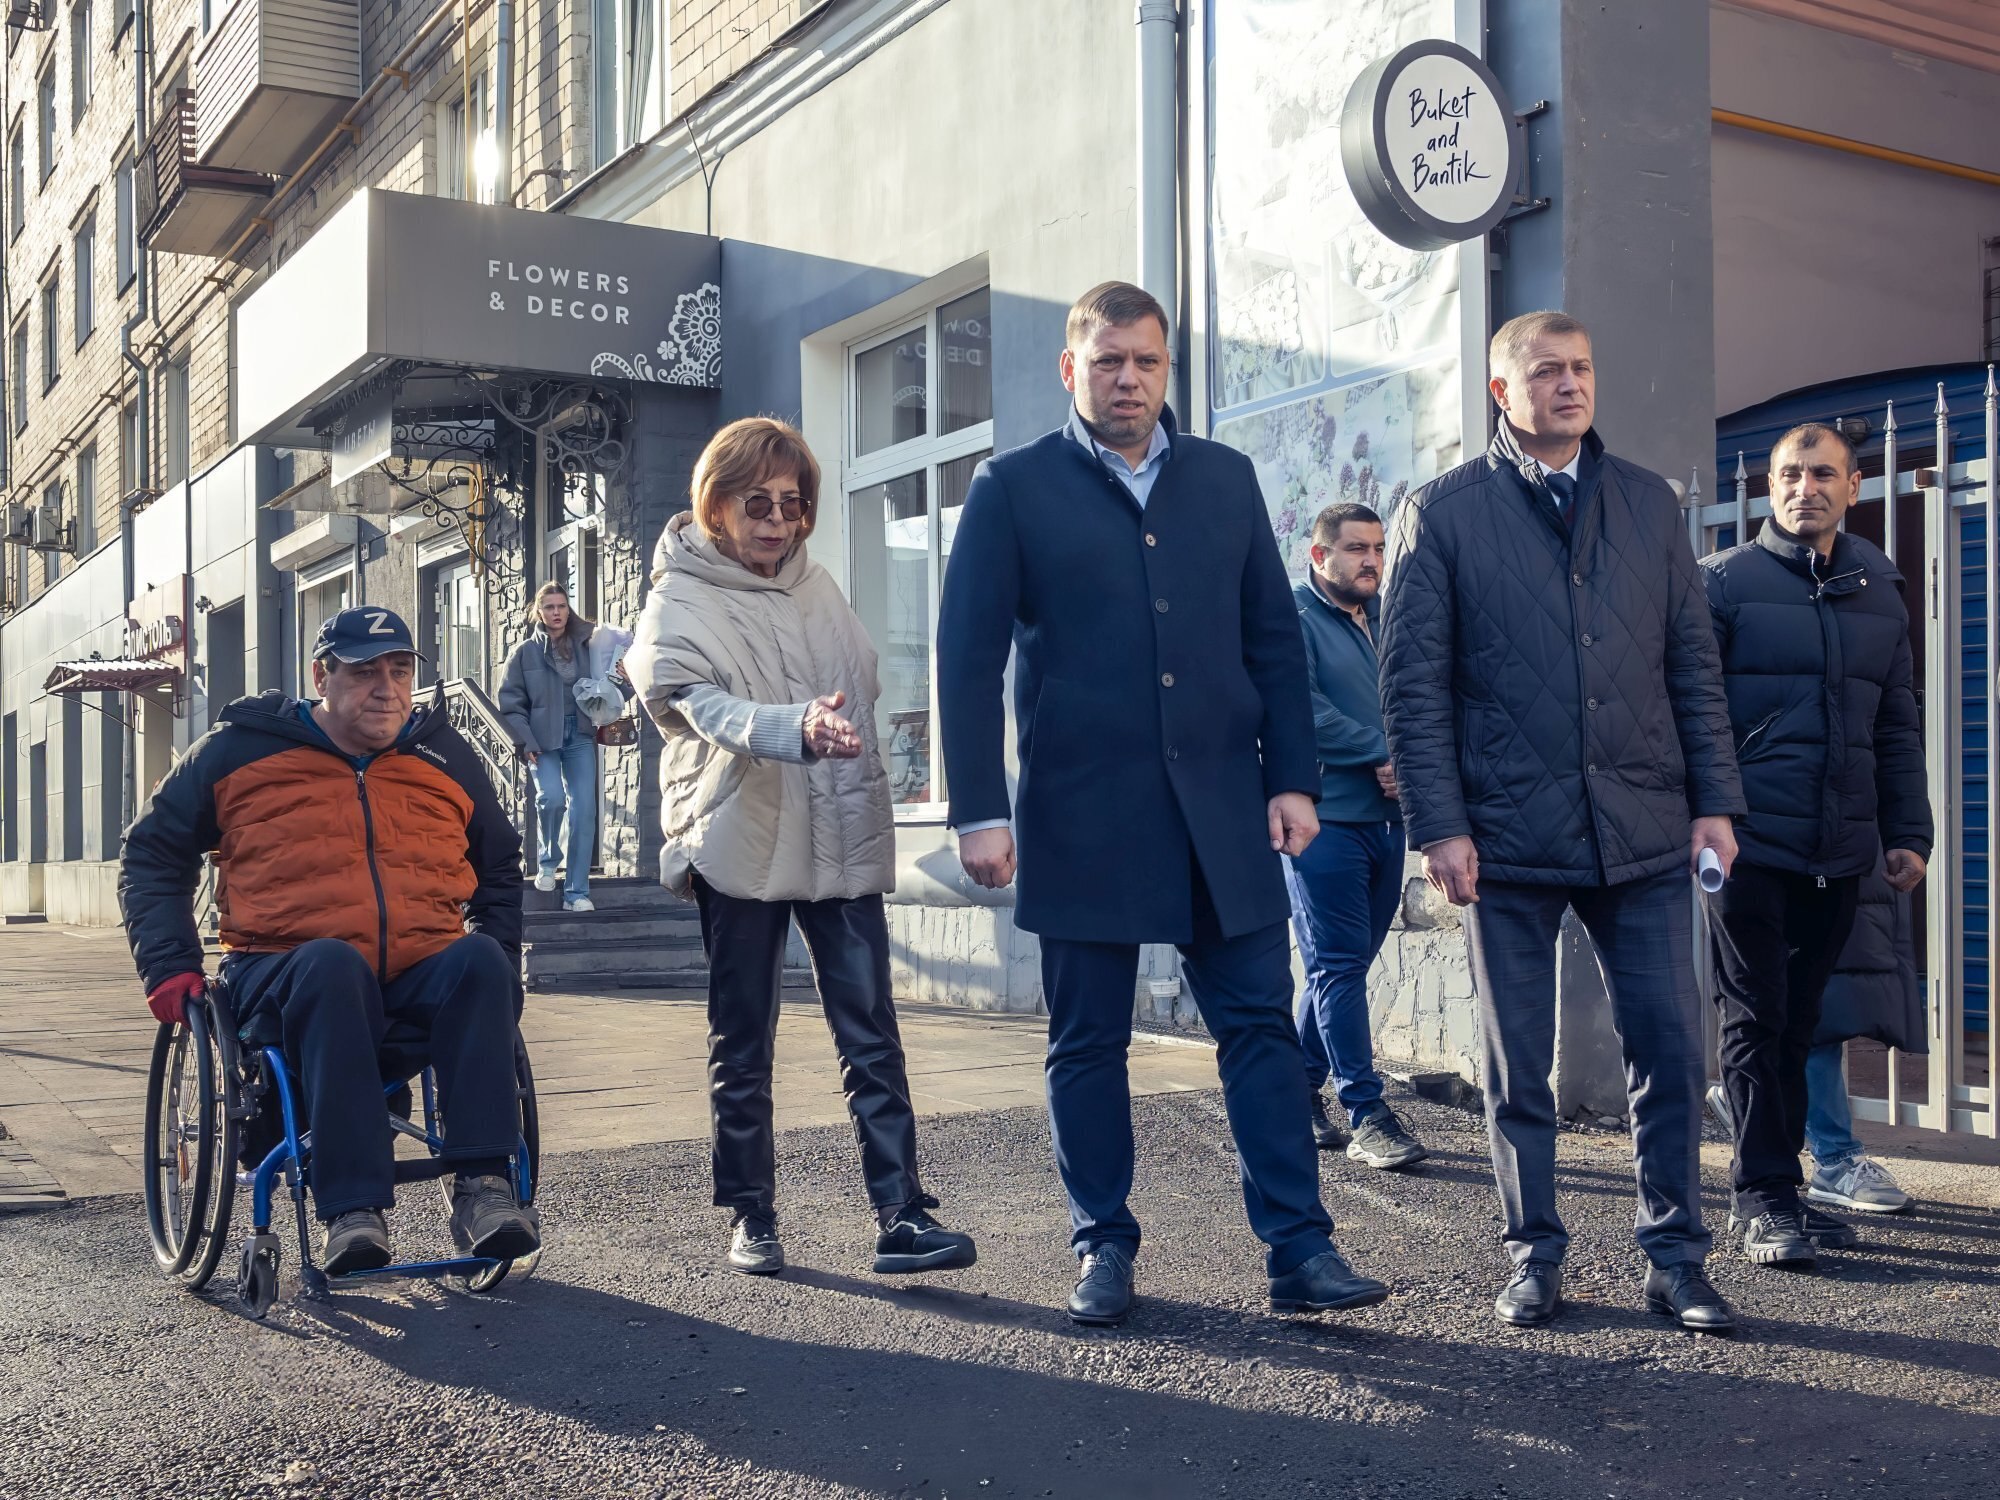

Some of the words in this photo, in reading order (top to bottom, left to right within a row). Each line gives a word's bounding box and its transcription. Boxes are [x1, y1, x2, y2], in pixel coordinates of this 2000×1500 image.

[1408, 86, 1478, 128] Buket
[1426, 122, 1460, 151] and
[1411, 150, 1491, 192] Bantik
[488, 259, 629, 295] FLOWERS
[489, 291, 505, 311] &
[527, 295, 630, 325] DECOR
[364, 612, 395, 635] Z
